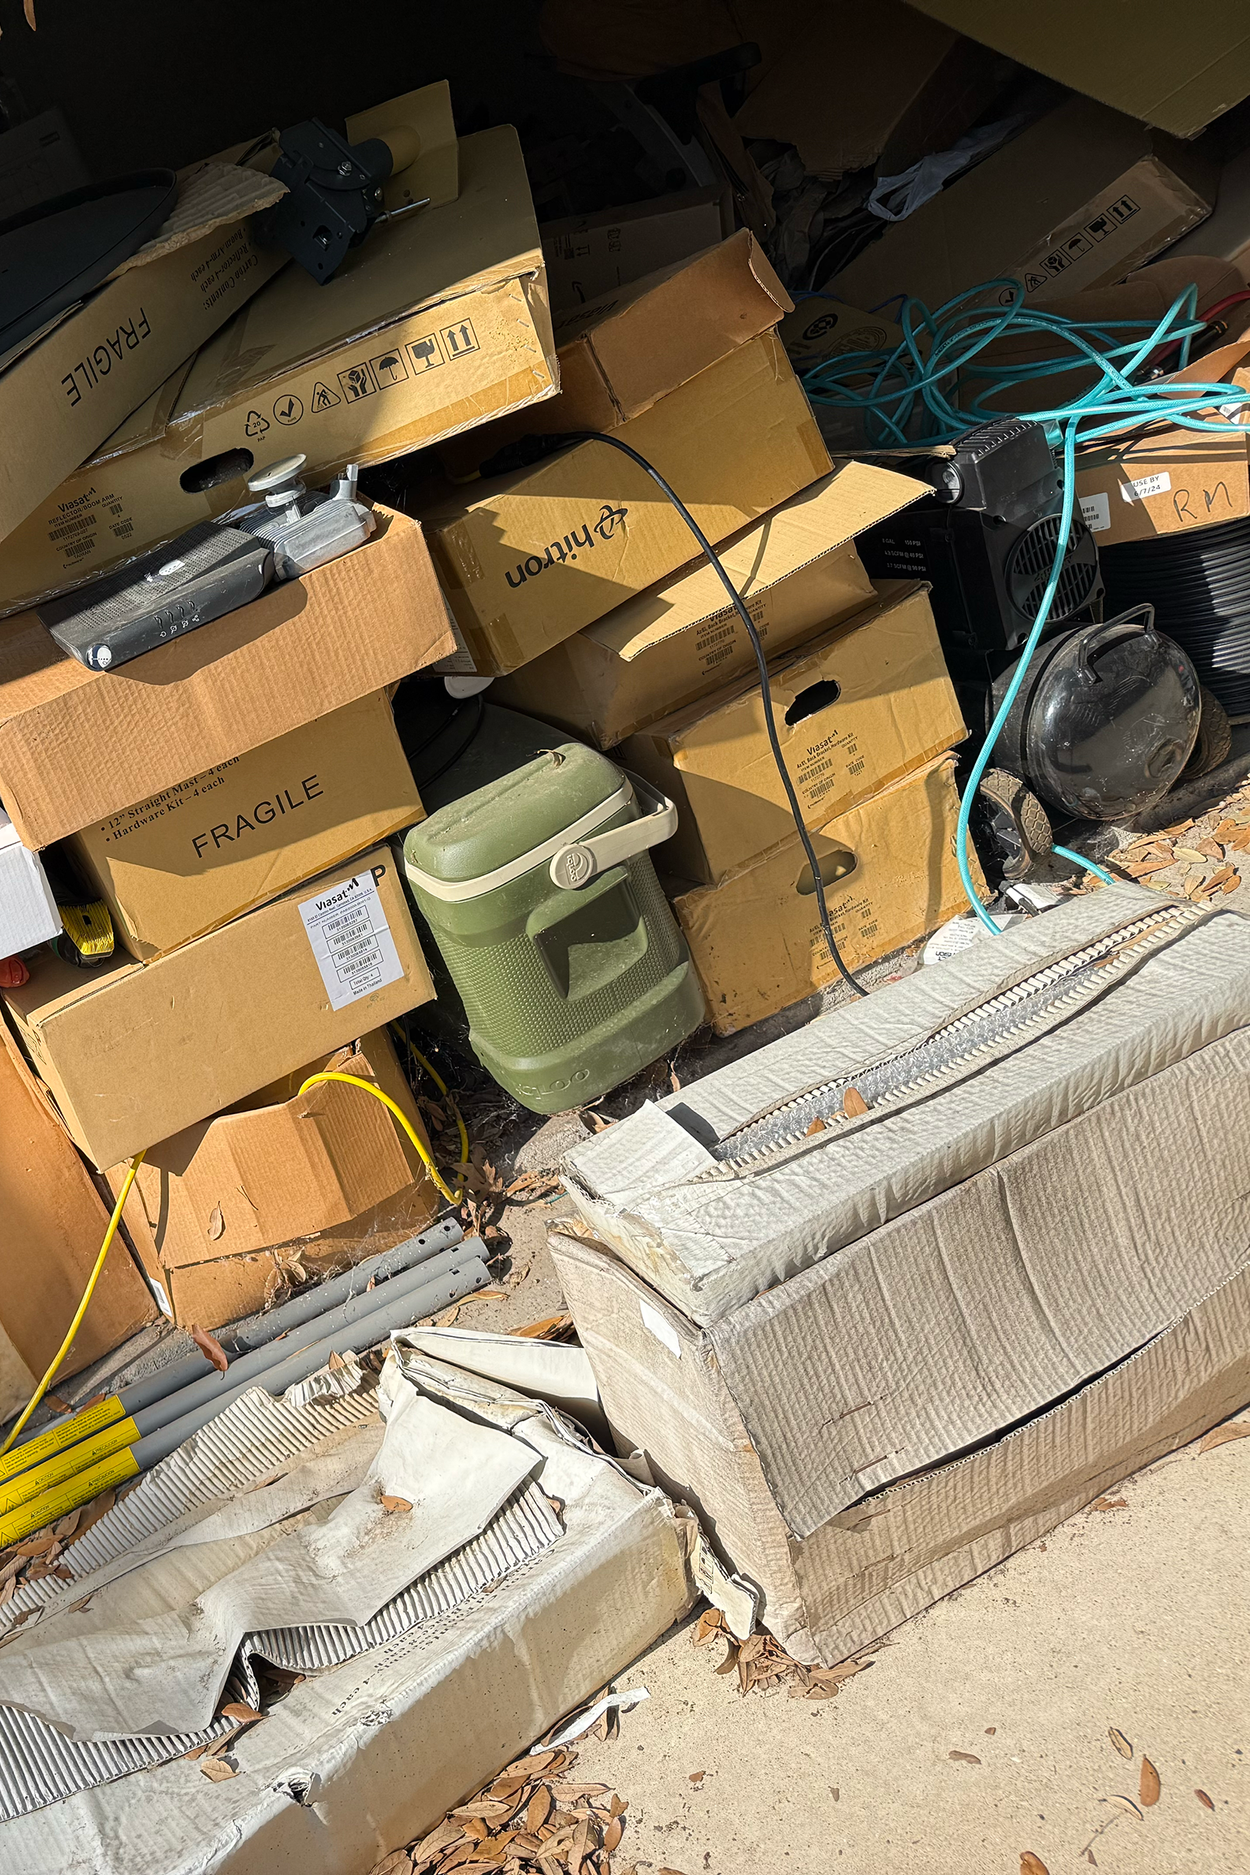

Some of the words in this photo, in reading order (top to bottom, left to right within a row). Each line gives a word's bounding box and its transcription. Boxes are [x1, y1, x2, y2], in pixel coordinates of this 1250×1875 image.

[233, 253, 259, 280] Carton
[200, 275, 235, 310] Contents:
[61, 307, 151, 407] FRAGILE
[1132, 478, 1147, 488] USE
[57, 493, 90, 513] Viasat
[505, 524, 595, 588] hitron
[806, 736, 831, 755] Viasat
[126, 790, 172, 820] Straight
[171, 776, 199, 795] Mast
[206, 767, 214, 776] 4
[111, 807, 165, 840] Hardware
[165, 797, 184, 811] Kit
[191, 788, 200, 797] 4
[199, 775, 225, 793] each
[192, 774, 324, 858] FRAGILE
[314, 889, 349, 911] Viasat
[828, 902, 847, 916] asat
[352, 987, 363, 996] Made
[366, 976, 383, 988] Thailand
